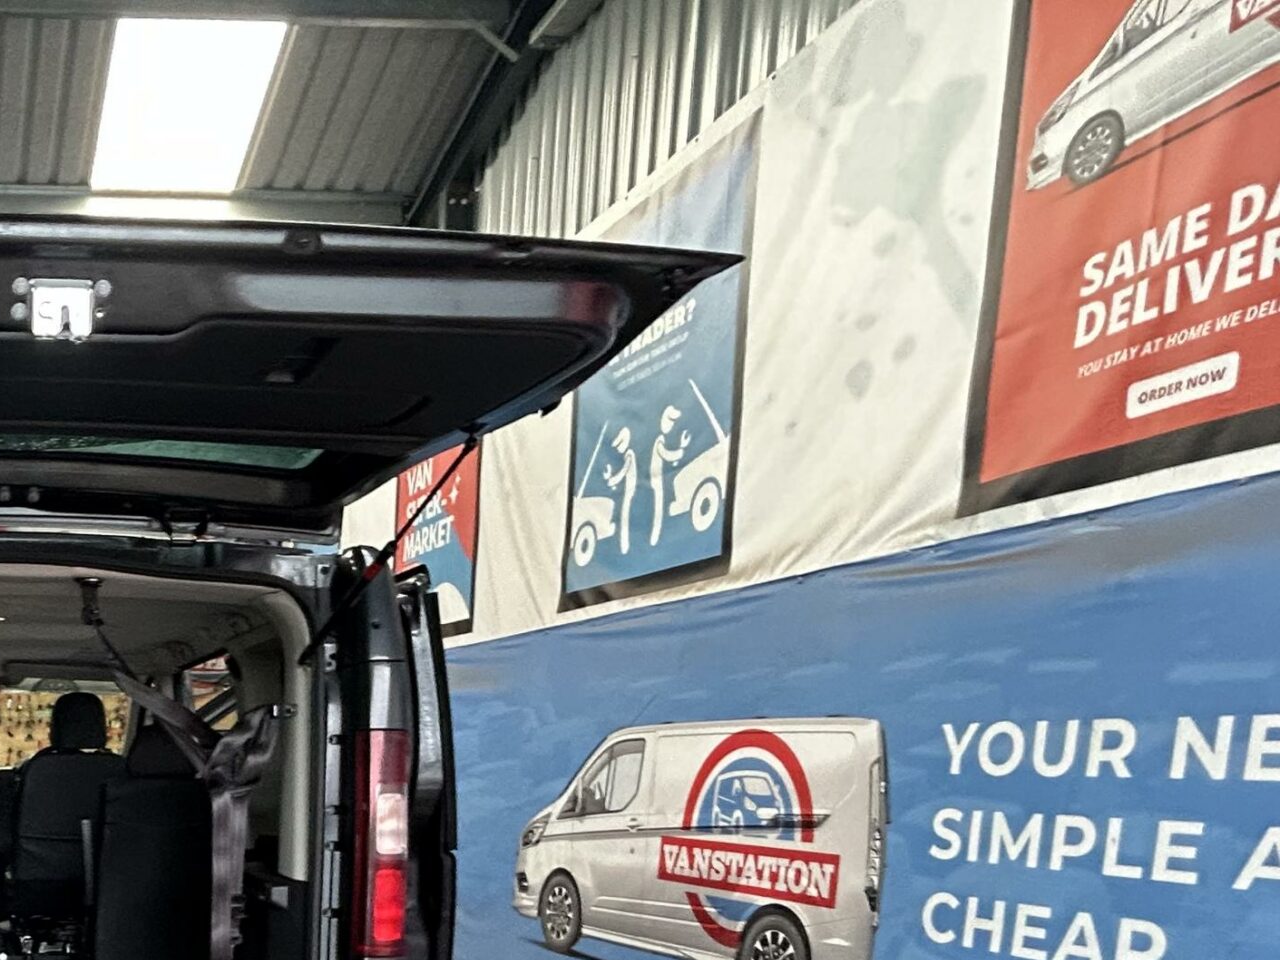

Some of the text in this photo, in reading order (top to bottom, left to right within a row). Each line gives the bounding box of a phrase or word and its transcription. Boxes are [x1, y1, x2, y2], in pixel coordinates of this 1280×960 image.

[1079, 202, 1212, 298] SAME
[1073, 226, 1280, 350] DELIVER
[1078, 298, 1280, 379] YOU STAY AT HOME WE DEL
[1137, 366, 1228, 405] ORDER NOW
[406, 458, 433, 497] VAN
[402, 515, 455, 562] MARKET
[941, 714, 1280, 782] YOUR NE
[662, 844, 836, 899] VANSTATION
[928, 807, 1280, 891] SIMPLE A
